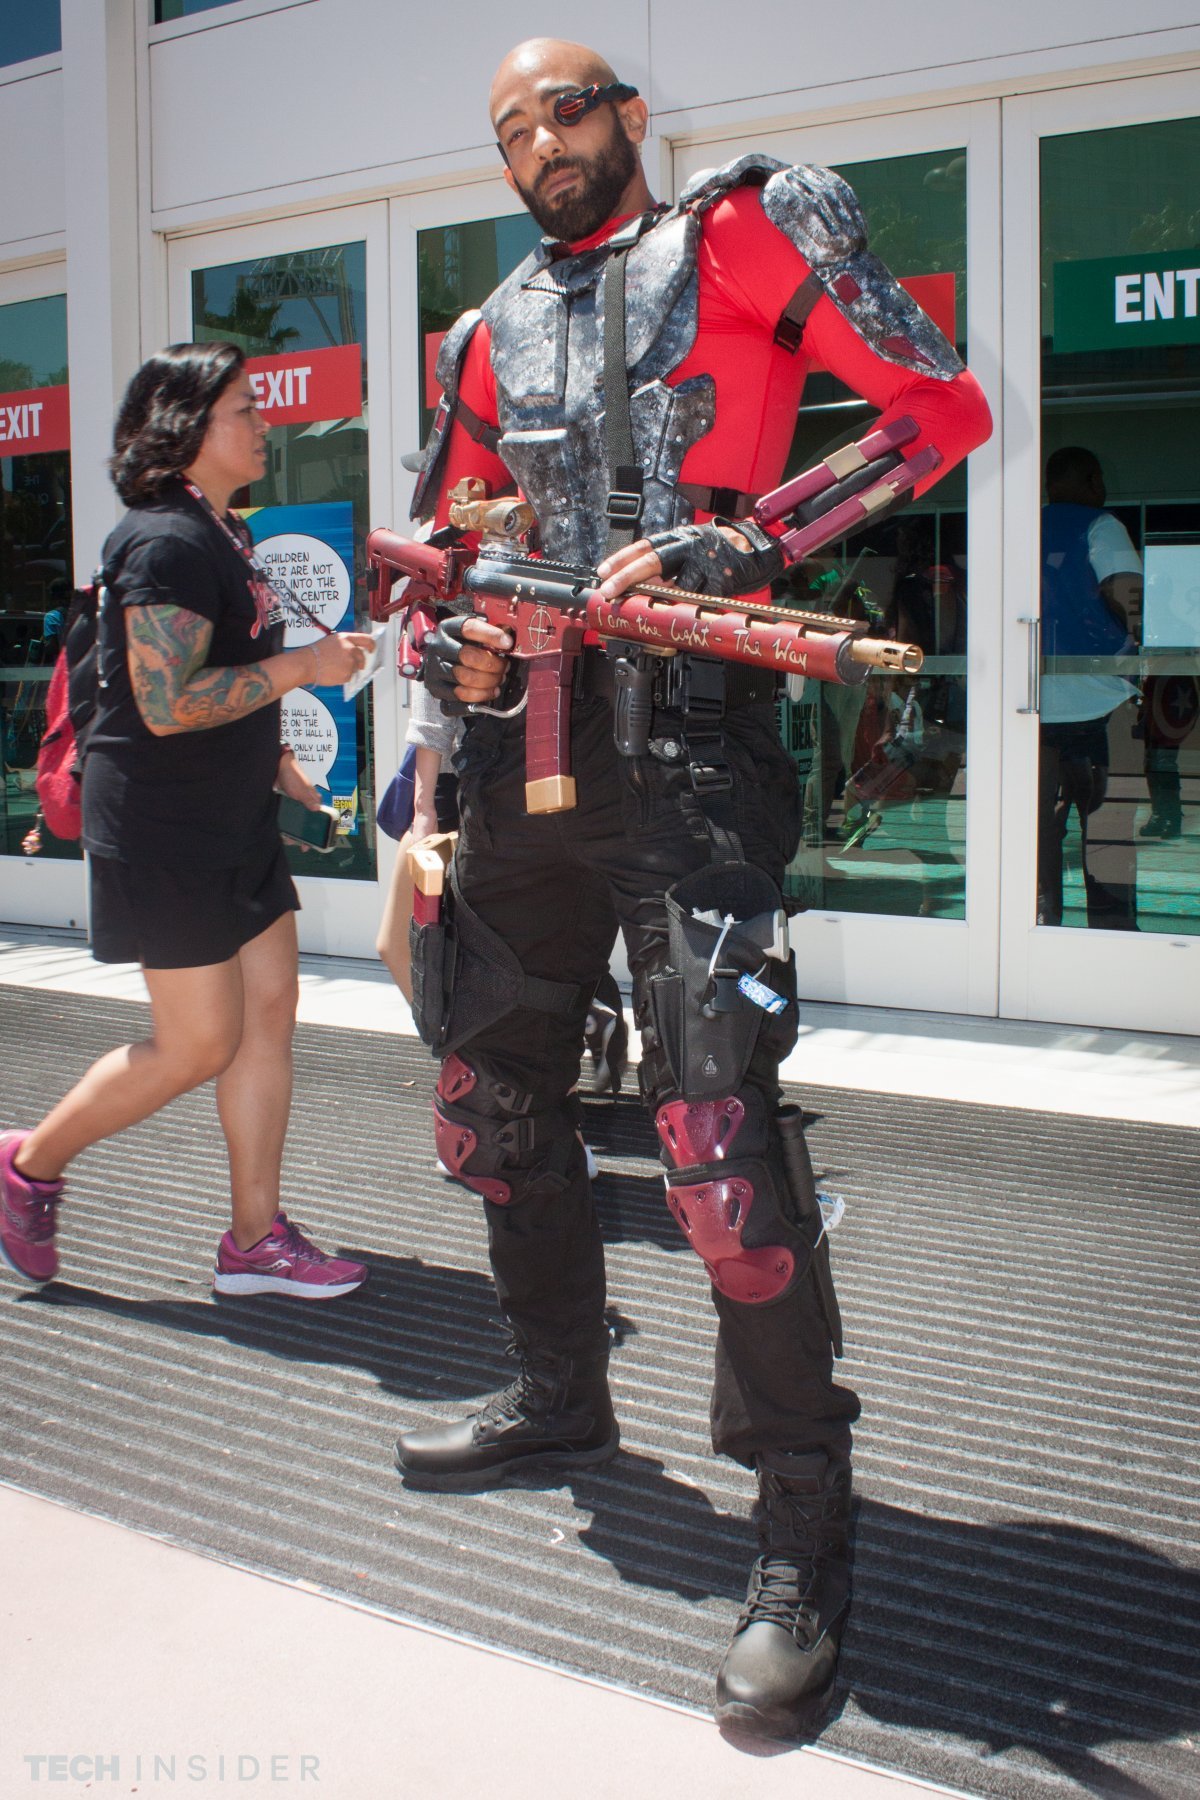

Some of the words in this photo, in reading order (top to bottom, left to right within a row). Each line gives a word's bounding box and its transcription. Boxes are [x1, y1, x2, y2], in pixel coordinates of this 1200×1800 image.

[1115, 268, 1200, 323] ENT
[249, 366, 311, 409] EXIT
[264, 552, 310, 564] CHILDREN
[277, 566, 287, 577] 12
[290, 565, 309, 576] ARE
[313, 563, 333, 576] NOT
[290, 578, 313, 589] INTO
[317, 577, 336, 588] THE
[301, 590, 340, 602] CENTER
[596, 605, 603, 626] I
[607, 614, 633, 630] am
[636, 614, 662, 637] the
[733, 628, 762, 657] The
[772, 637, 808, 672] Way
[292, 709, 309, 717] HALL
[312, 709, 317, 717] H
[290, 719, 301, 727] ON
[303, 719, 319, 727] THE
[293, 729, 303, 737] OF
[306, 729, 324, 738] HALL
[294, 743, 314, 752] ONLY
[316, 744, 333, 752] LINE
[299, 753, 316, 762] HALL
[319, 753, 324, 762] H
